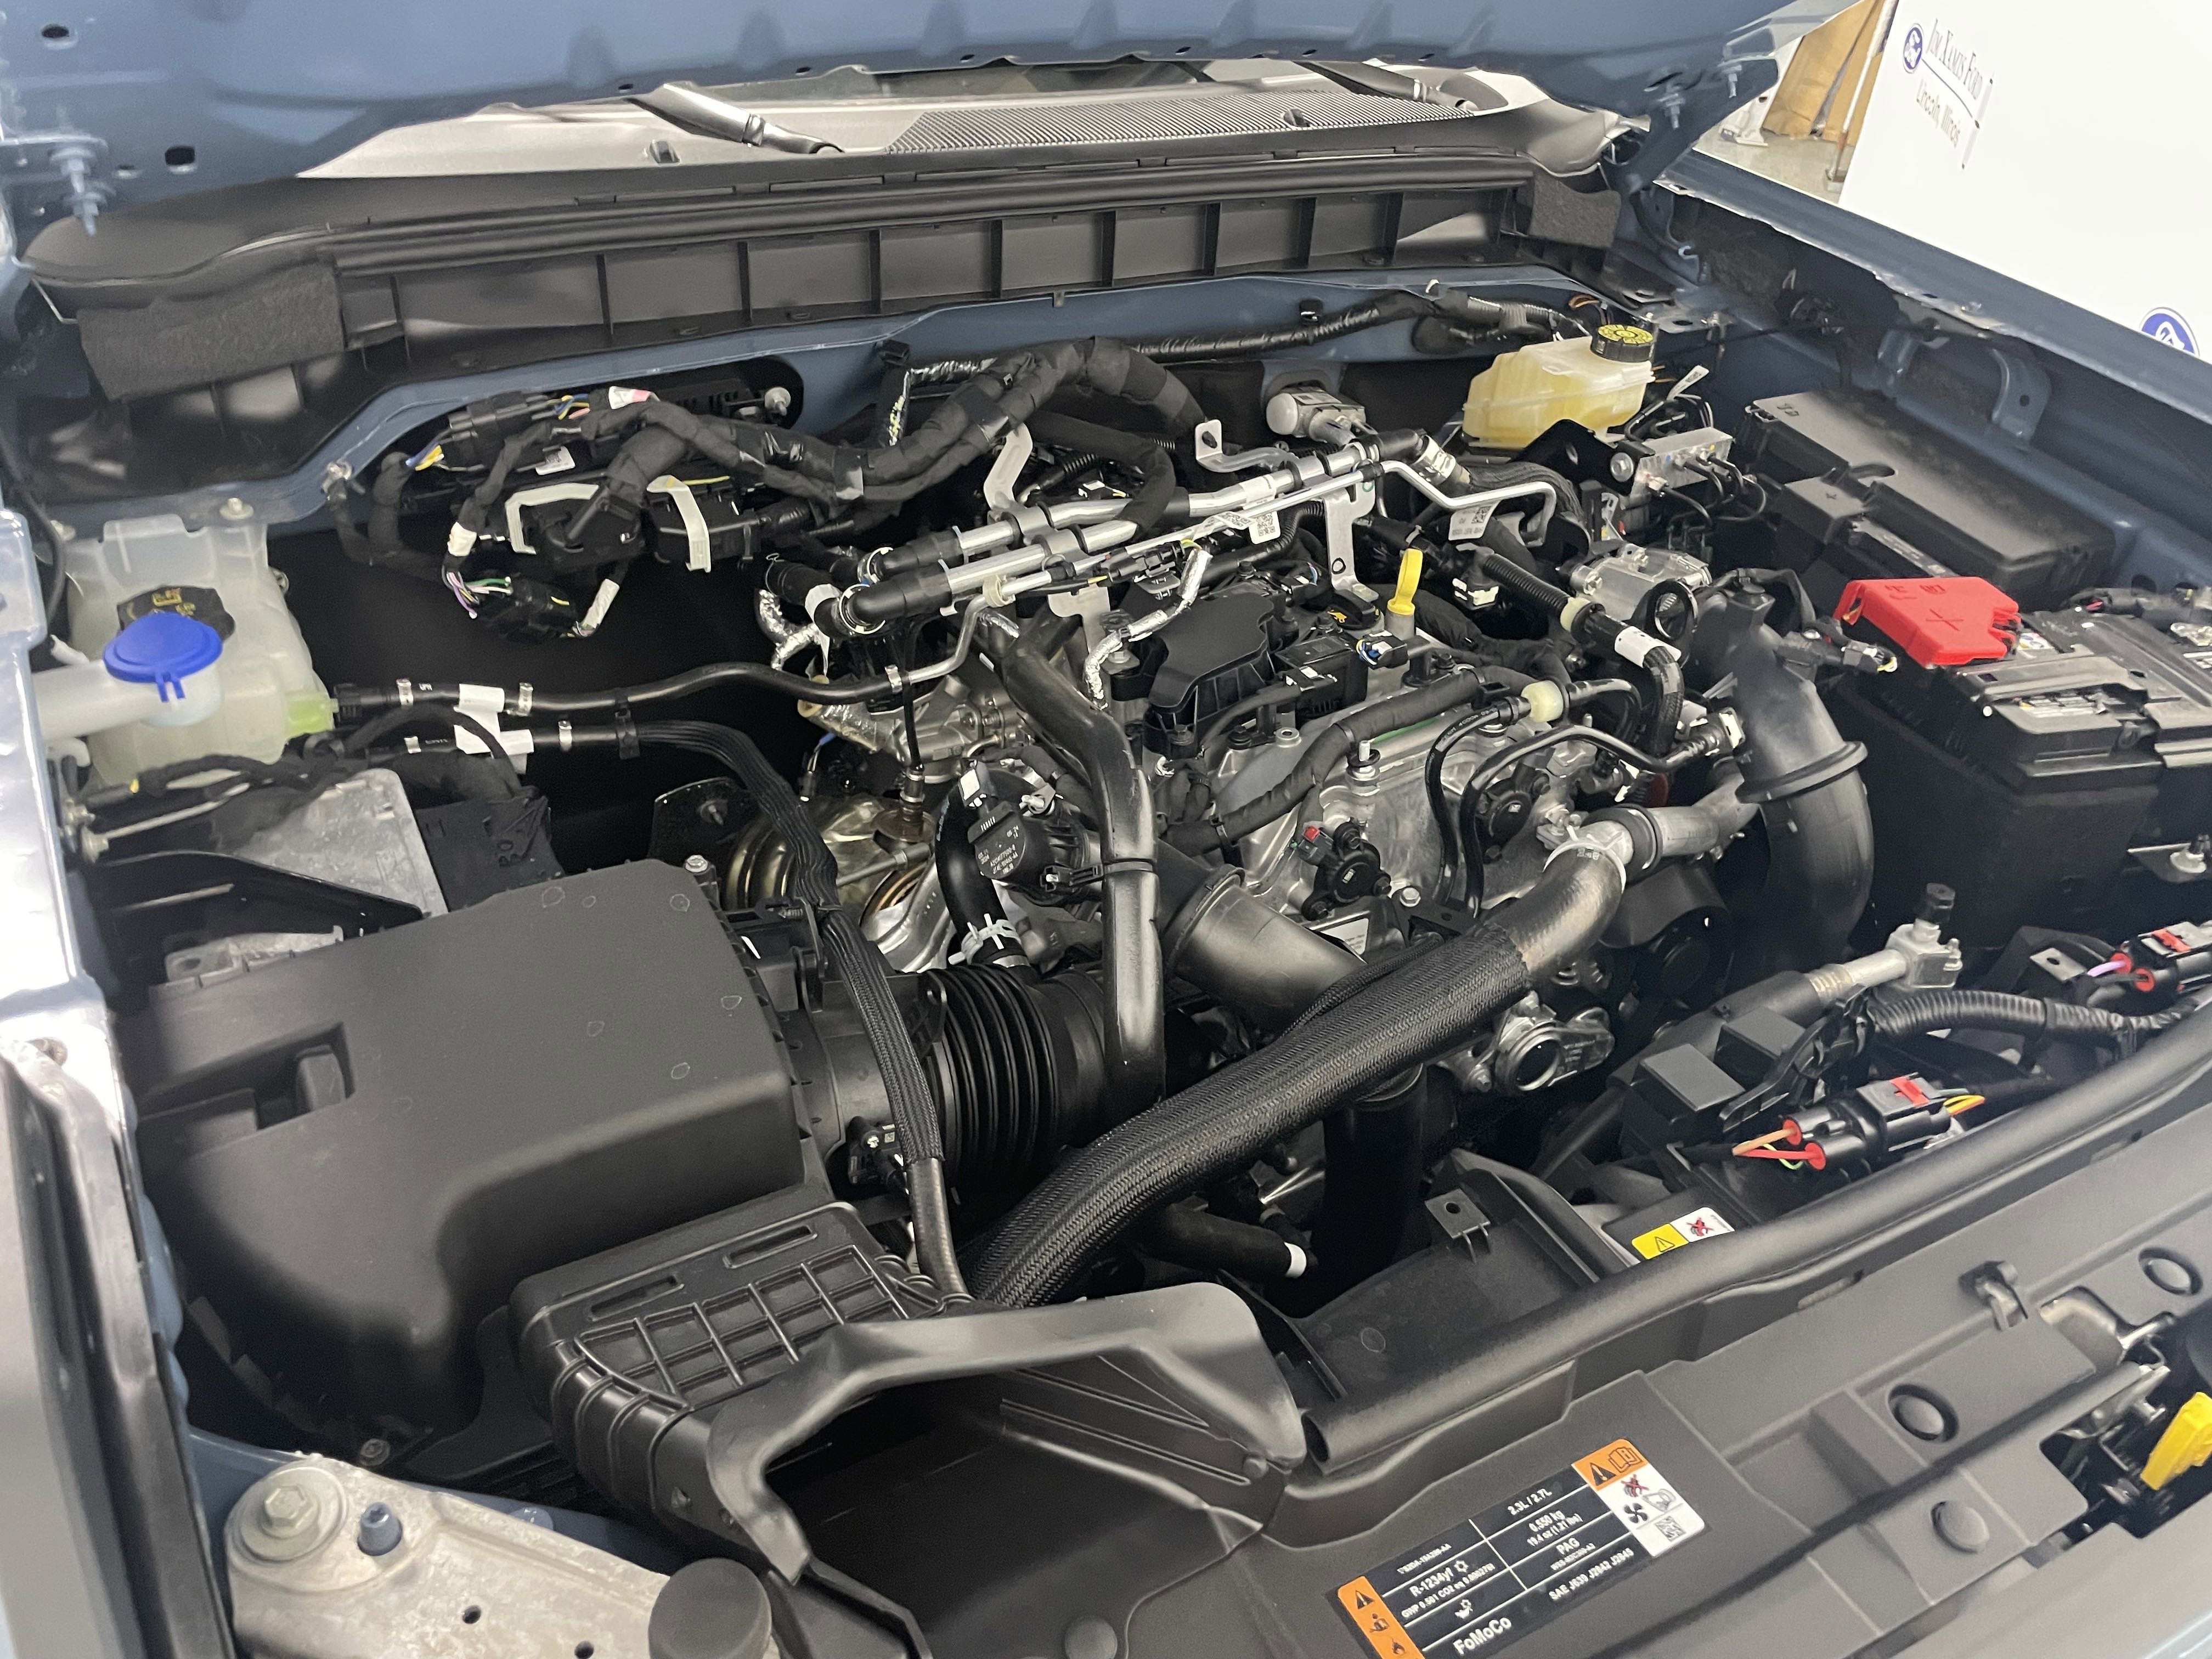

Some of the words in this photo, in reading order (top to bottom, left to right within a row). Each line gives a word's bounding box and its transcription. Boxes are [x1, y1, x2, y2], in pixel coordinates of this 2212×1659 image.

[1508, 1501, 1530, 1515] 2.3L
[1526, 1496, 1533, 1505] /
[1530, 1488, 1552, 1503] 2.7L
[1529, 1515, 1553, 1532] 0.550
[1549, 1510, 1565, 1521] kg
[1556, 1538, 1580, 1555] PAG
[1409, 1567, 1454, 1597] R-1234yf
[1549, 1584, 1570, 1600] SAE
[1568, 1573, 1589, 1590] J639
[1588, 1561, 1612, 1579] J2842
[1401, 1604, 1419, 1618] GWP
[1438, 1585, 1455, 1598] CO2
[1453, 1617, 1511, 1655] FoMoCo
